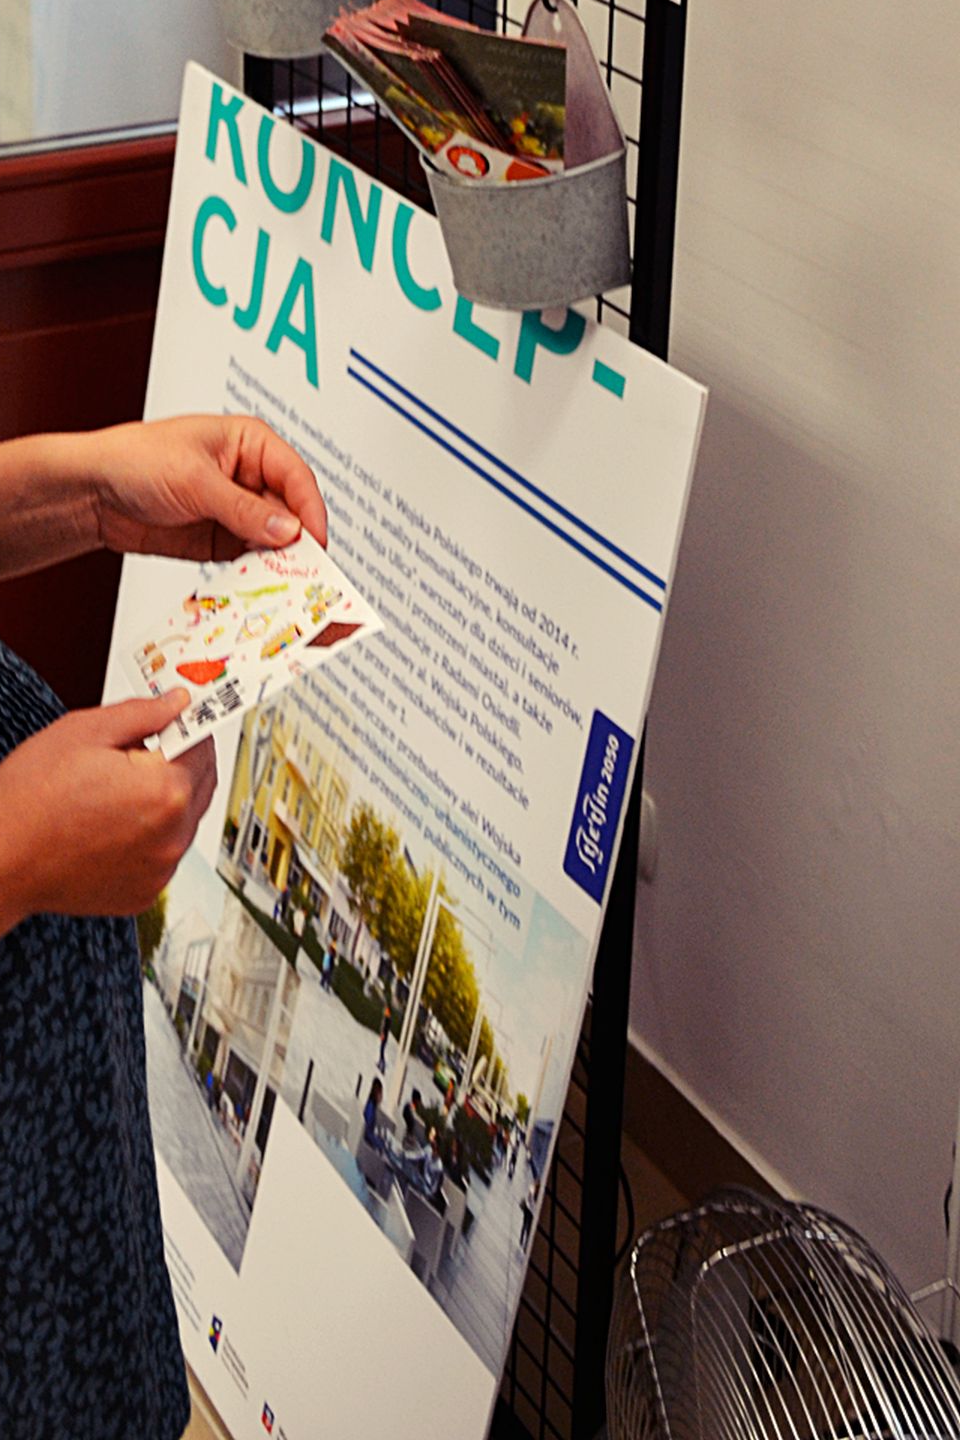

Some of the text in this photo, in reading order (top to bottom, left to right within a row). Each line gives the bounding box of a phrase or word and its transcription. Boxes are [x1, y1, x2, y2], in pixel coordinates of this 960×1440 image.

[190, 195, 319, 388] CJA
[288, 407, 299, 425] do
[301, 420, 351, 469] rewitalizacji
[353, 464, 381, 493] części
[396, 496, 430, 535] Wojska
[433, 526, 481, 577] Polskiego
[484, 571, 518, 610] trwają
[520, 603, 537, 623] od
[538, 613, 569, 648] 2014
[570, 643, 578, 659] r.
[380, 516, 412, 550] analizy
[415, 542, 491, 619] komunikacyjne,
[496, 610, 558, 673] konsultacje
[351, 664, 385, 703] wariant
[366, 562, 404, 602] urzędzie
[411, 603, 467, 657] przestrzeni
[511, 690, 519, 705] a
[522, 697, 552, 733] także
[377, 598, 430, 655] konsultacje
[441, 655, 479, 699] Radami
[481, 692, 520, 738] Osiedli.
[419, 579, 467, 628] warsztaty
[469, 621, 485, 644] dla
[487, 637, 520, 672] dzieci
[528, 672, 582, 729] seniorów,
[431, 676, 467, 720] Wojska
[470, 712, 522, 772] Polskiego.
[350, 691, 395, 742] dotyczące
[397, 739, 457, 804] przebudowy
[459, 800, 479, 825] alei
[481, 817, 520, 865] Wojska
[364, 647, 390, 678] przez
[392, 674, 456, 739] mieszkańców
[464, 742, 474, 757] w
[476, 753, 528, 808] rezultacie
[600, 732, 620, 786] 2050
[423, 826, 483, 892] publicznych
[486, 888, 496, 905] w
[498, 898, 520, 929] tym
